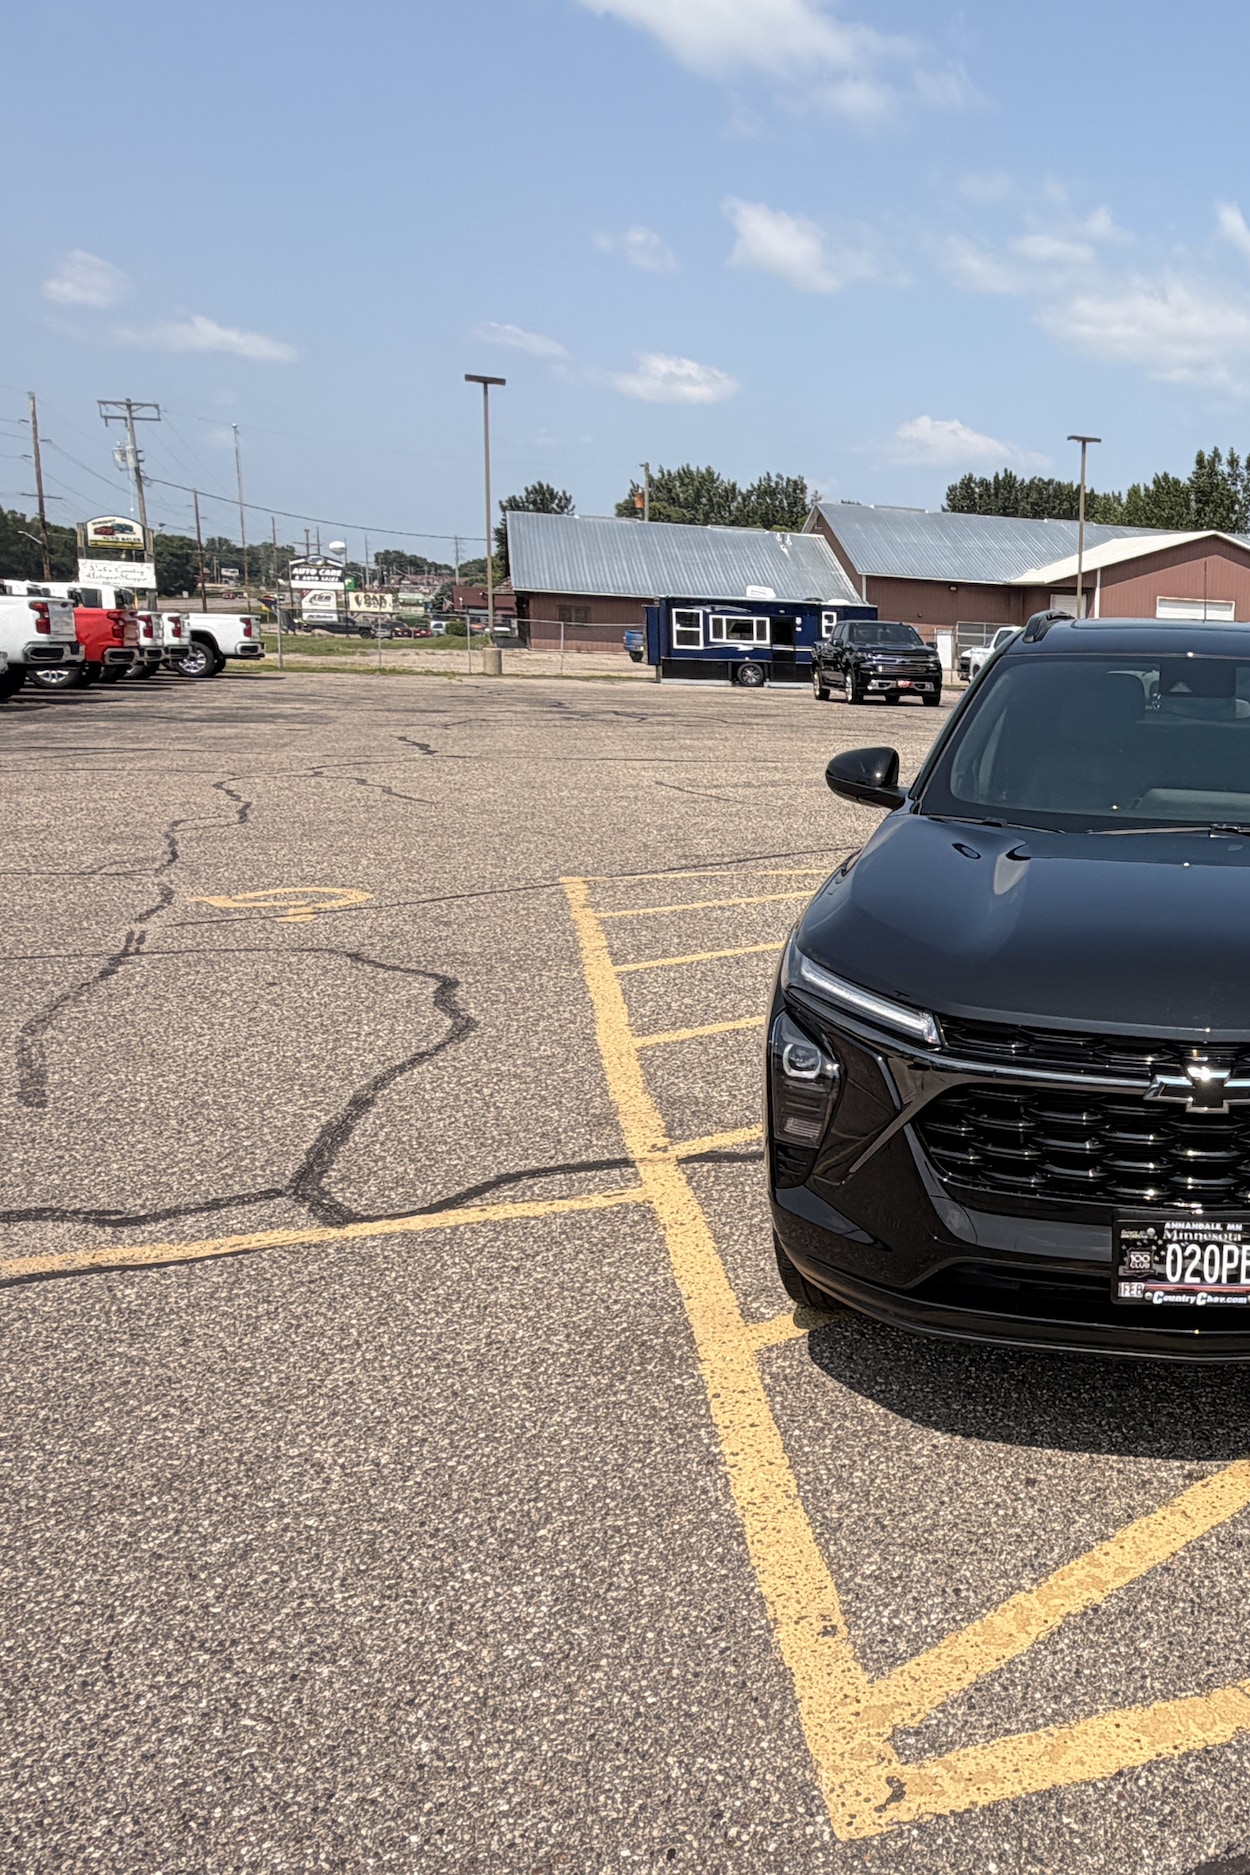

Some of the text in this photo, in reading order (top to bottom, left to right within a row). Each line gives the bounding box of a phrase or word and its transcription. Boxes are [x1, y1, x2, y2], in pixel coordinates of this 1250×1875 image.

[292, 567, 342, 576] AUTO CARE
[1226, 1223, 1243, 1231] MN
[1162, 1229, 1242, 1241] Minnesota
[1130, 1254, 1151, 1262] 100
[1130, 1261, 1151, 1269] CLUB
